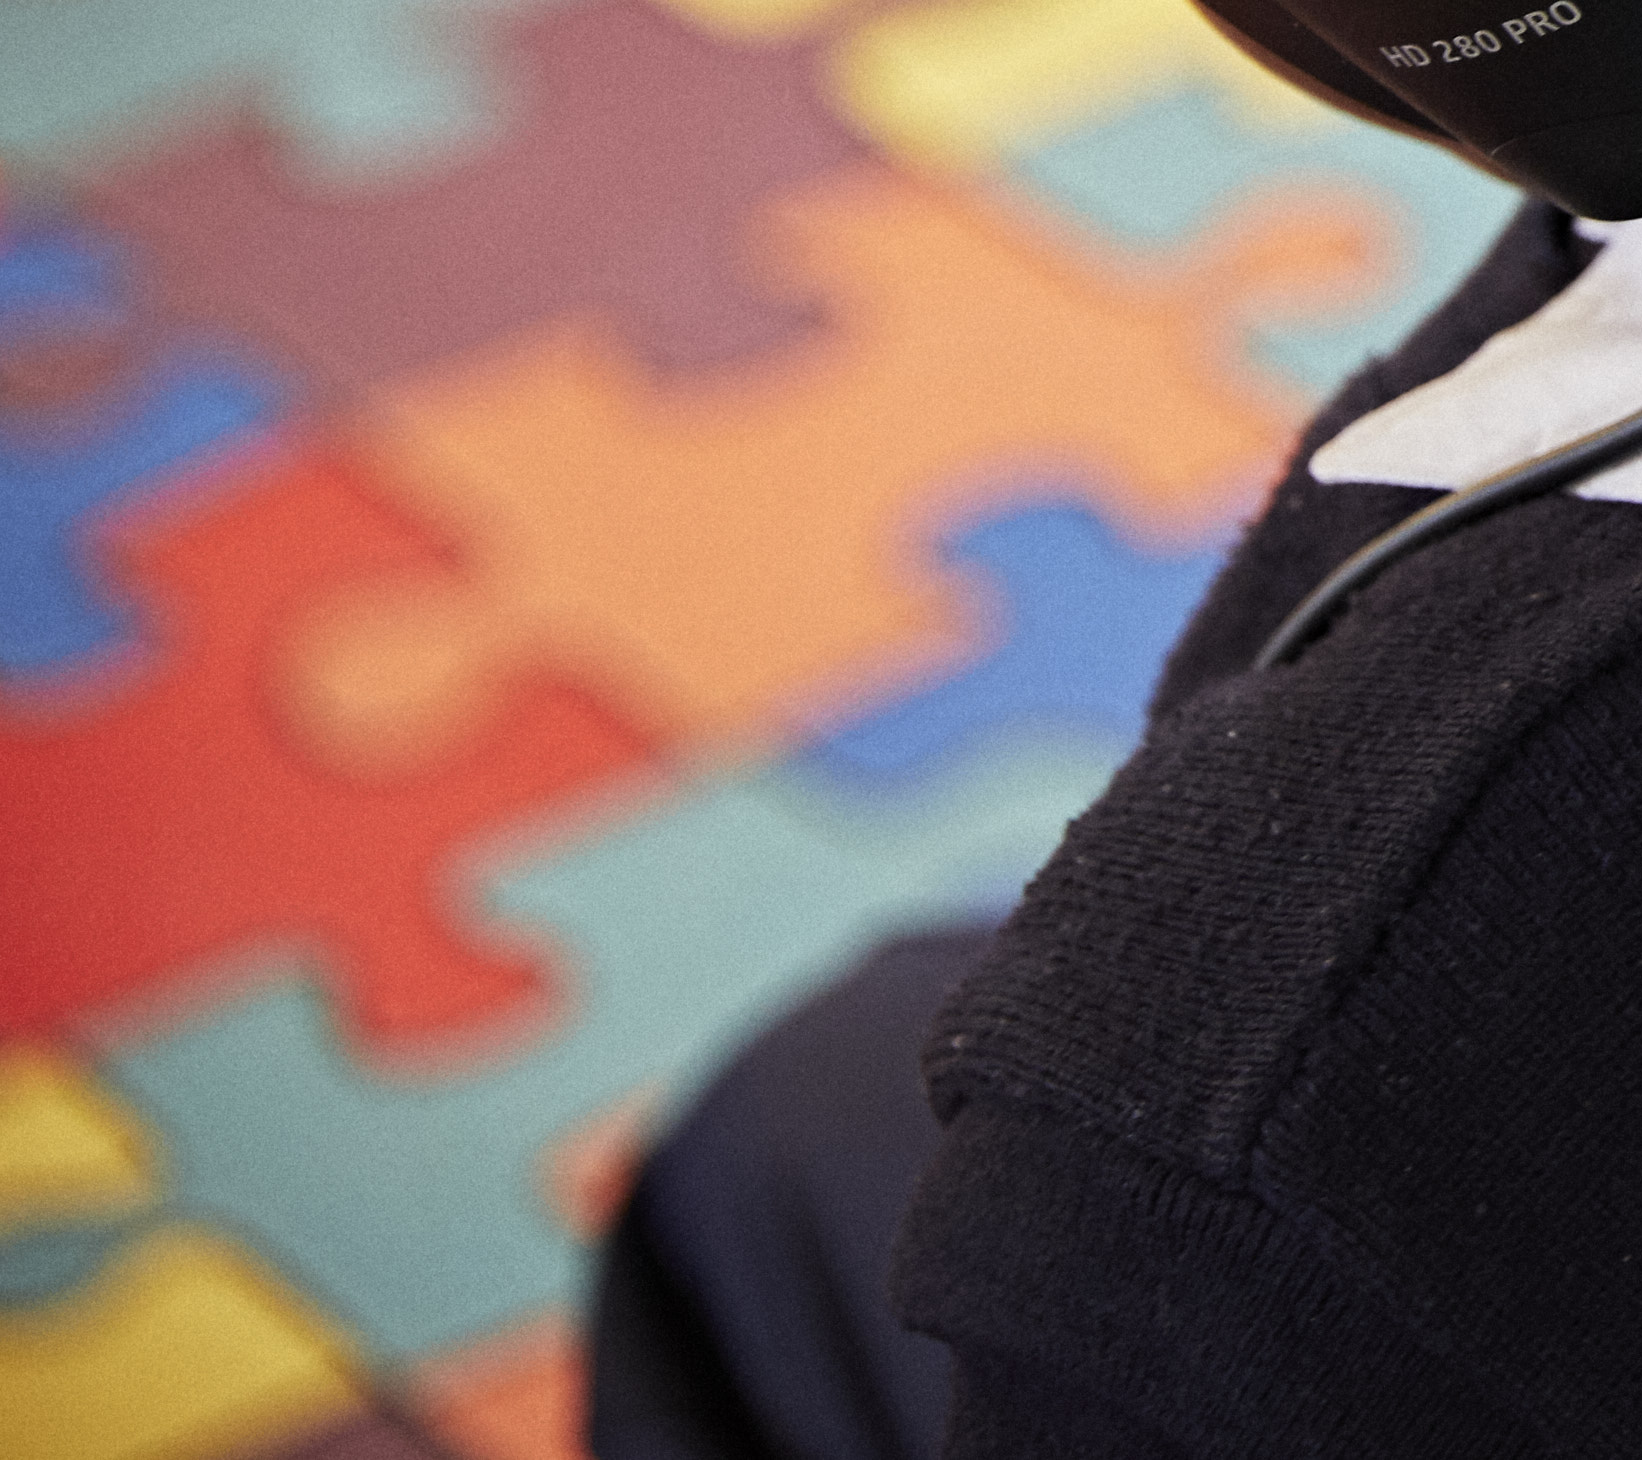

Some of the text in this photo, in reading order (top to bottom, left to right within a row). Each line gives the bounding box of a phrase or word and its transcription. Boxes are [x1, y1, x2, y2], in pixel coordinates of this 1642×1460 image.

[1379, 0, 1582, 69] HD 280 PRO
